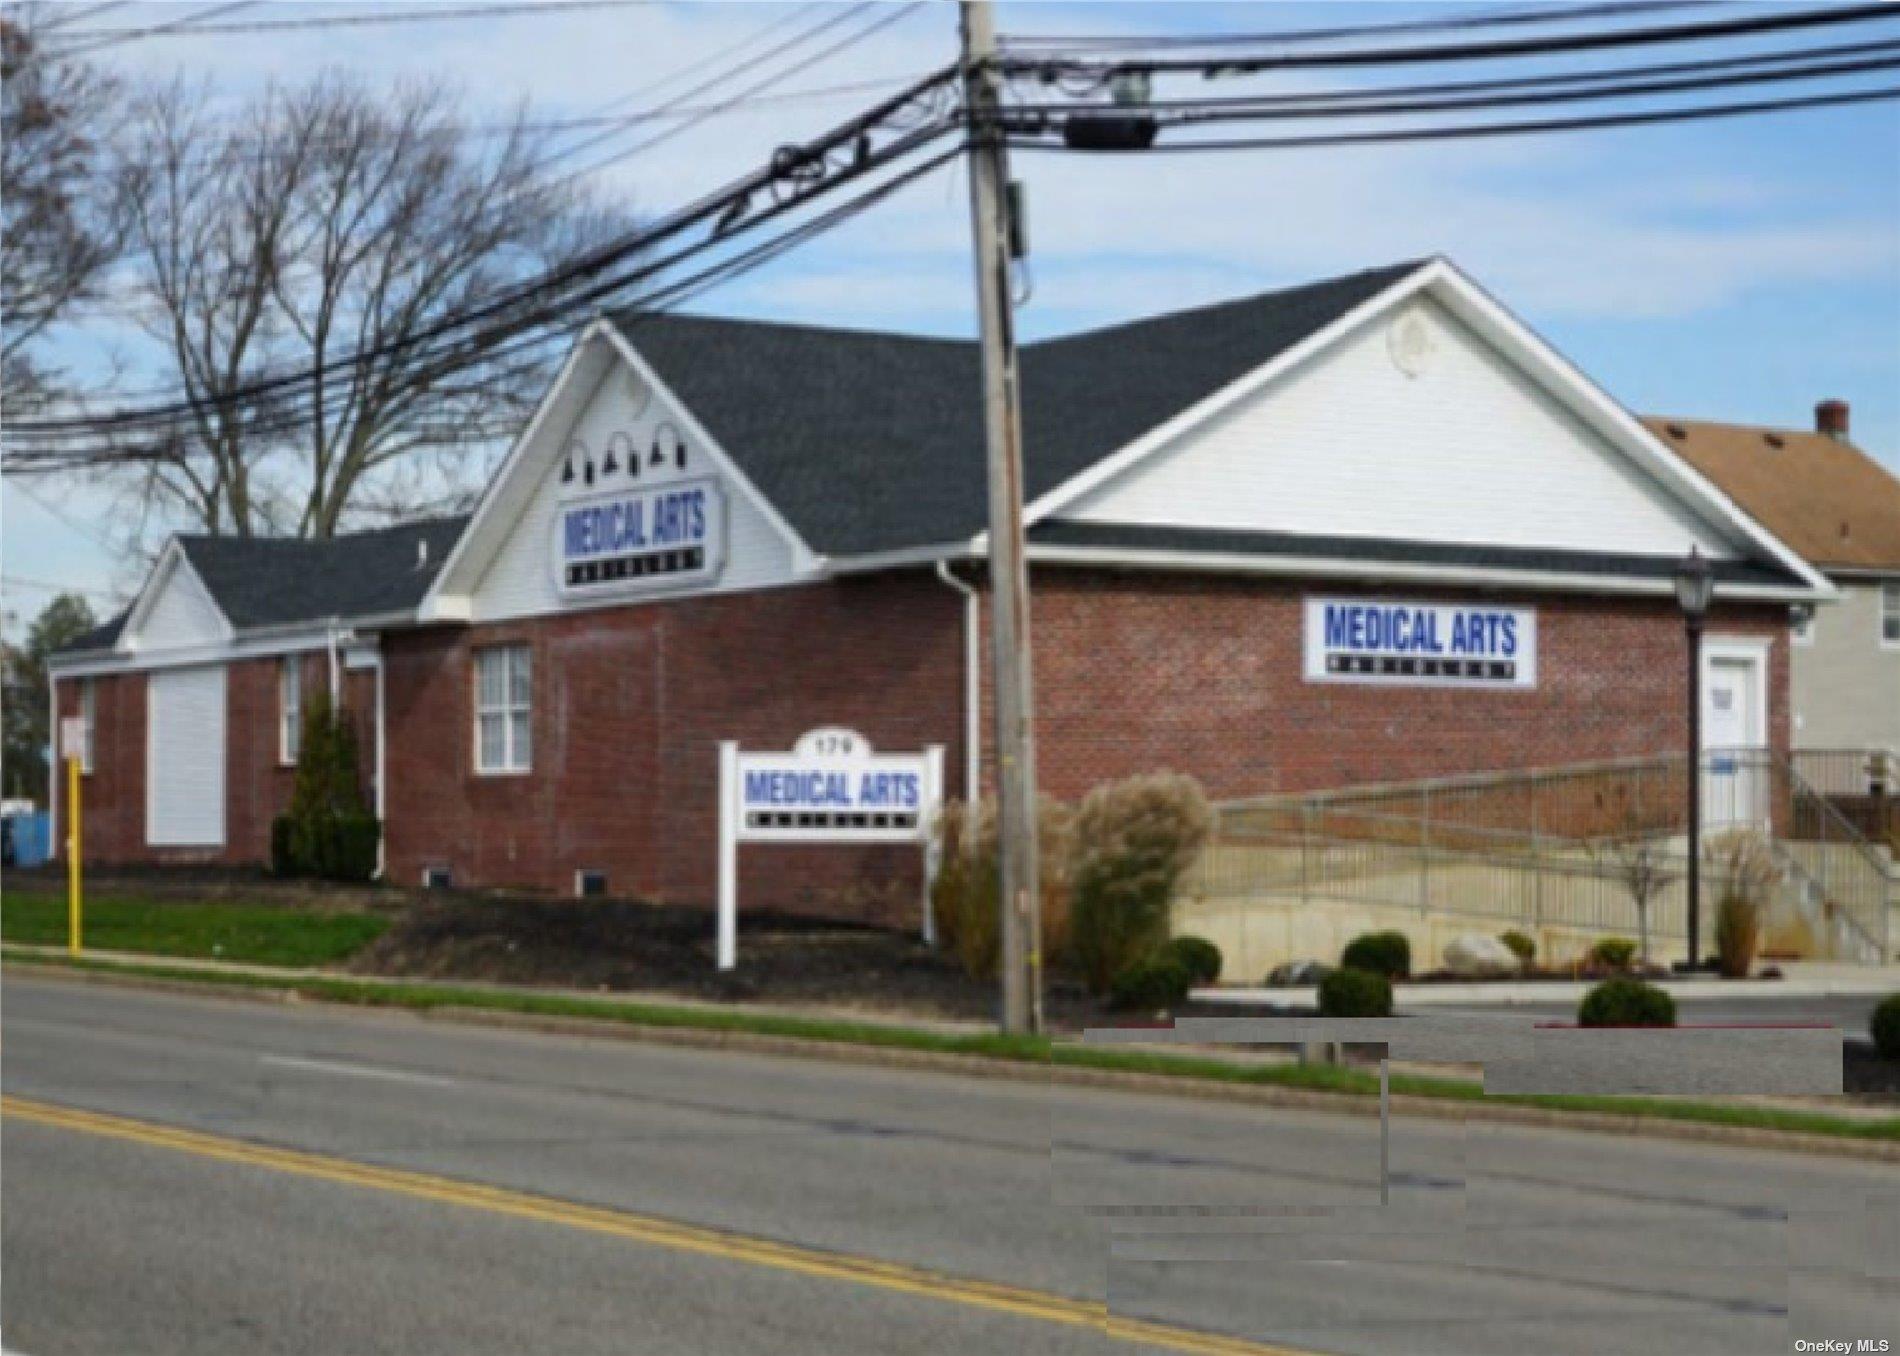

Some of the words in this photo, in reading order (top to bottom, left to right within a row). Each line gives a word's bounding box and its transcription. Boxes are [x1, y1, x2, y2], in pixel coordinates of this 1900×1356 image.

[565, 499, 646, 557] MEDICAL
[653, 490, 705, 544] ARTS
[1324, 605, 1442, 651] MEDICAL
[1452, 613, 1517, 656] ARTS
[745, 770, 852, 806] MEDICAL
[860, 770, 919, 807] ARTS
